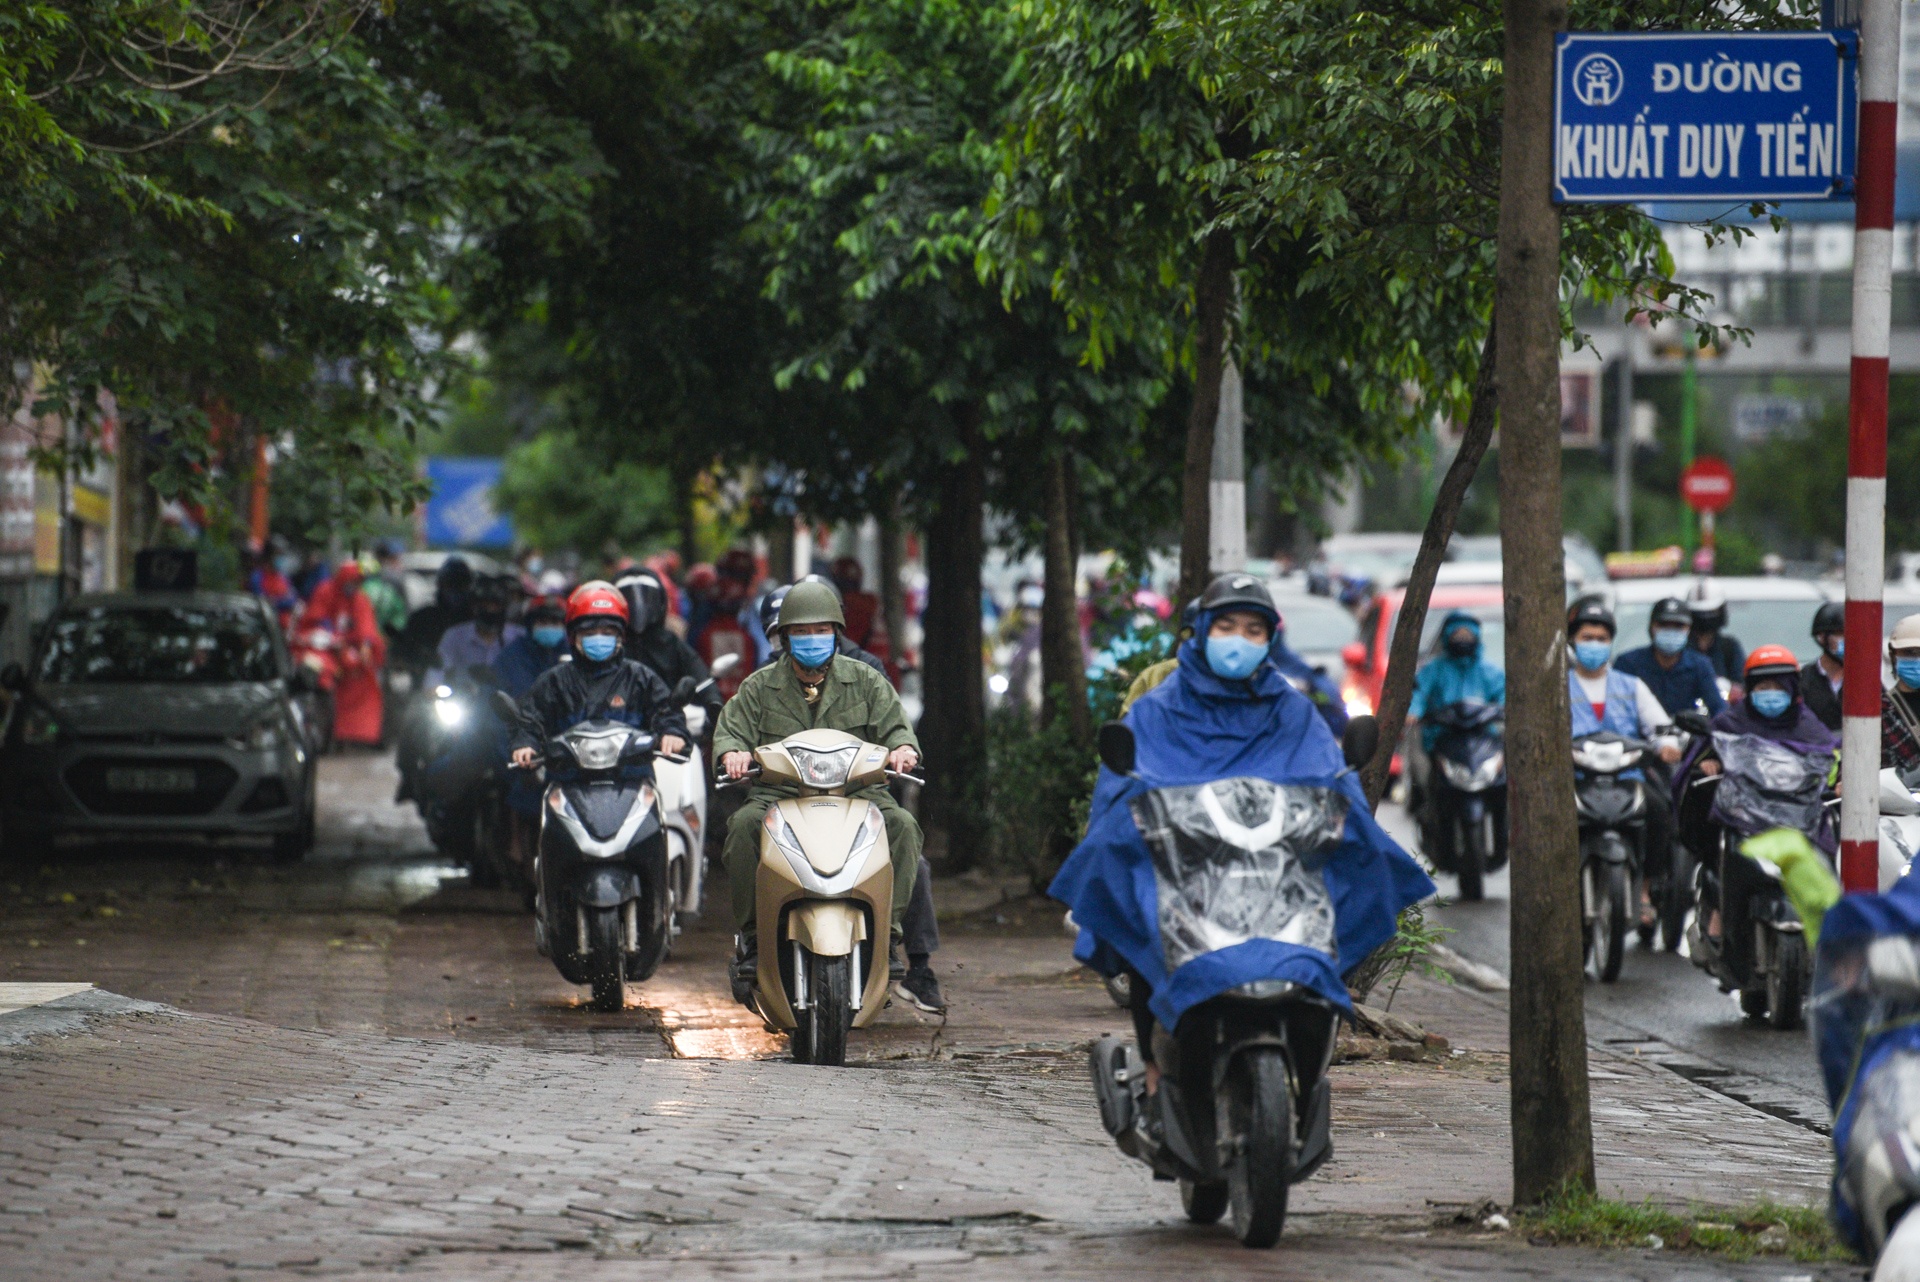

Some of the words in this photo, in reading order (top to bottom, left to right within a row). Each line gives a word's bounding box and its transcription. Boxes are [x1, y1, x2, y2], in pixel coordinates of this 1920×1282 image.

[1652, 52, 1802, 92] ĐƯỜNG
[1561, 105, 1669, 179] KHUẤT
[1678, 124, 1745, 178] DUY
[1756, 105, 1835, 178] TIẾN
